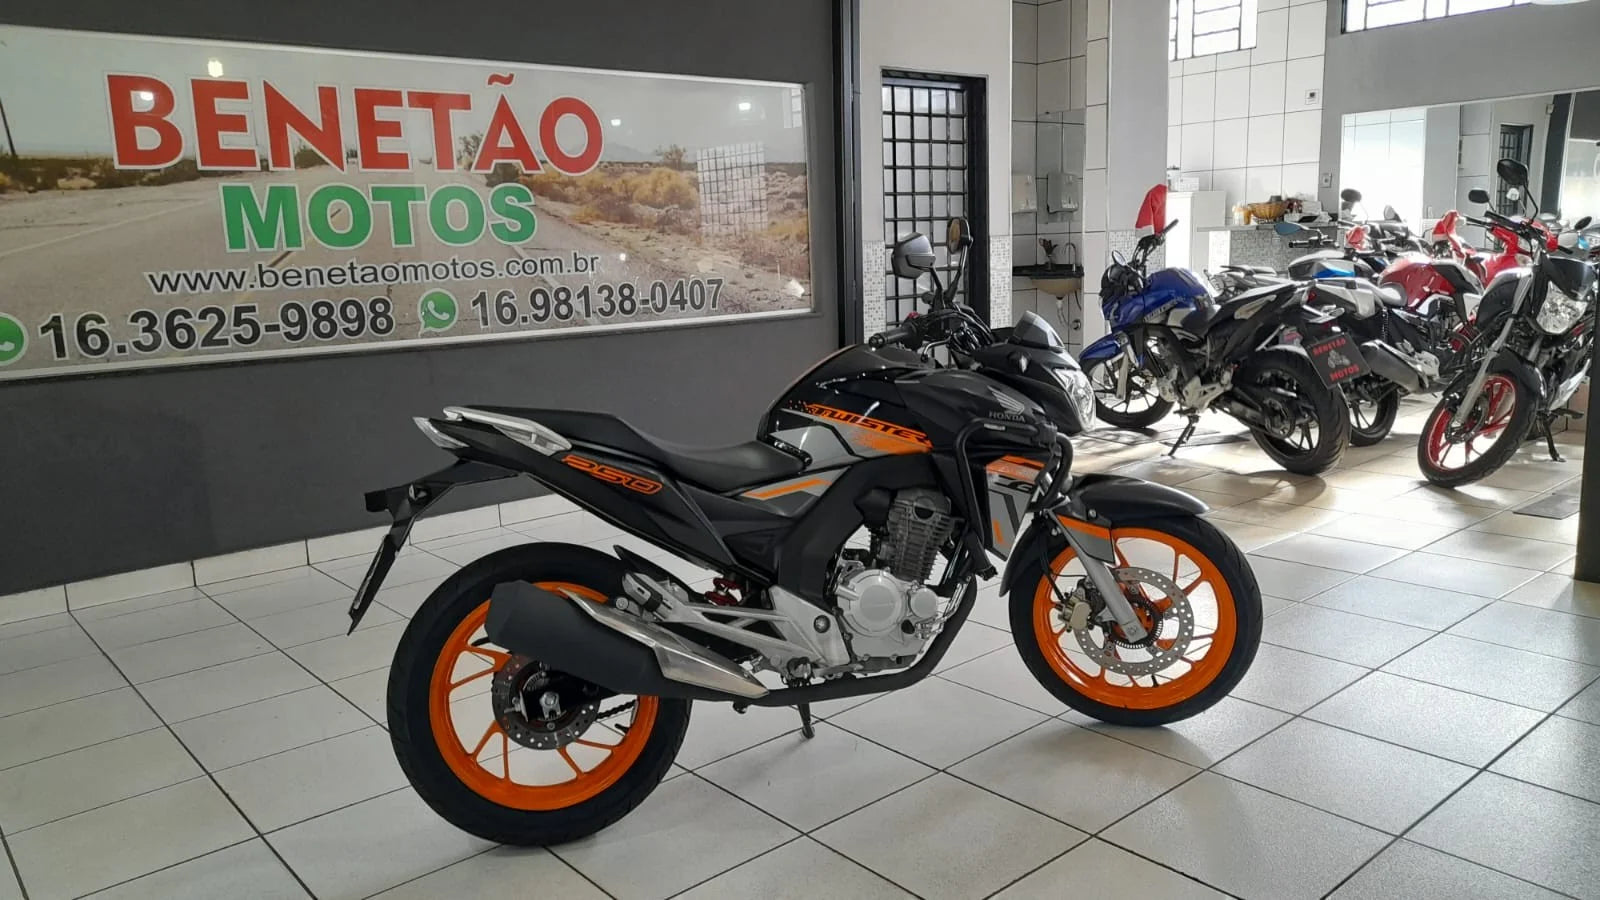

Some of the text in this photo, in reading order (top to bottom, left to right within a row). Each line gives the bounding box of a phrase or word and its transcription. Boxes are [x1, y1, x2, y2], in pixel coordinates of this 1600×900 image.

[106, 72, 604, 175] BENETÃO
[221, 184, 537, 251] MOTOS
[148, 252, 600, 294] www.benetaomotos.com.br
[471, 278, 725, 327] 16.98138-0407
[38, 297, 395, 360] 16.3625-9898
[1330, 363, 1360, 381] MOTOS
[988, 410, 1026, 423] HONDA
[561, 454, 663, 495] 250
